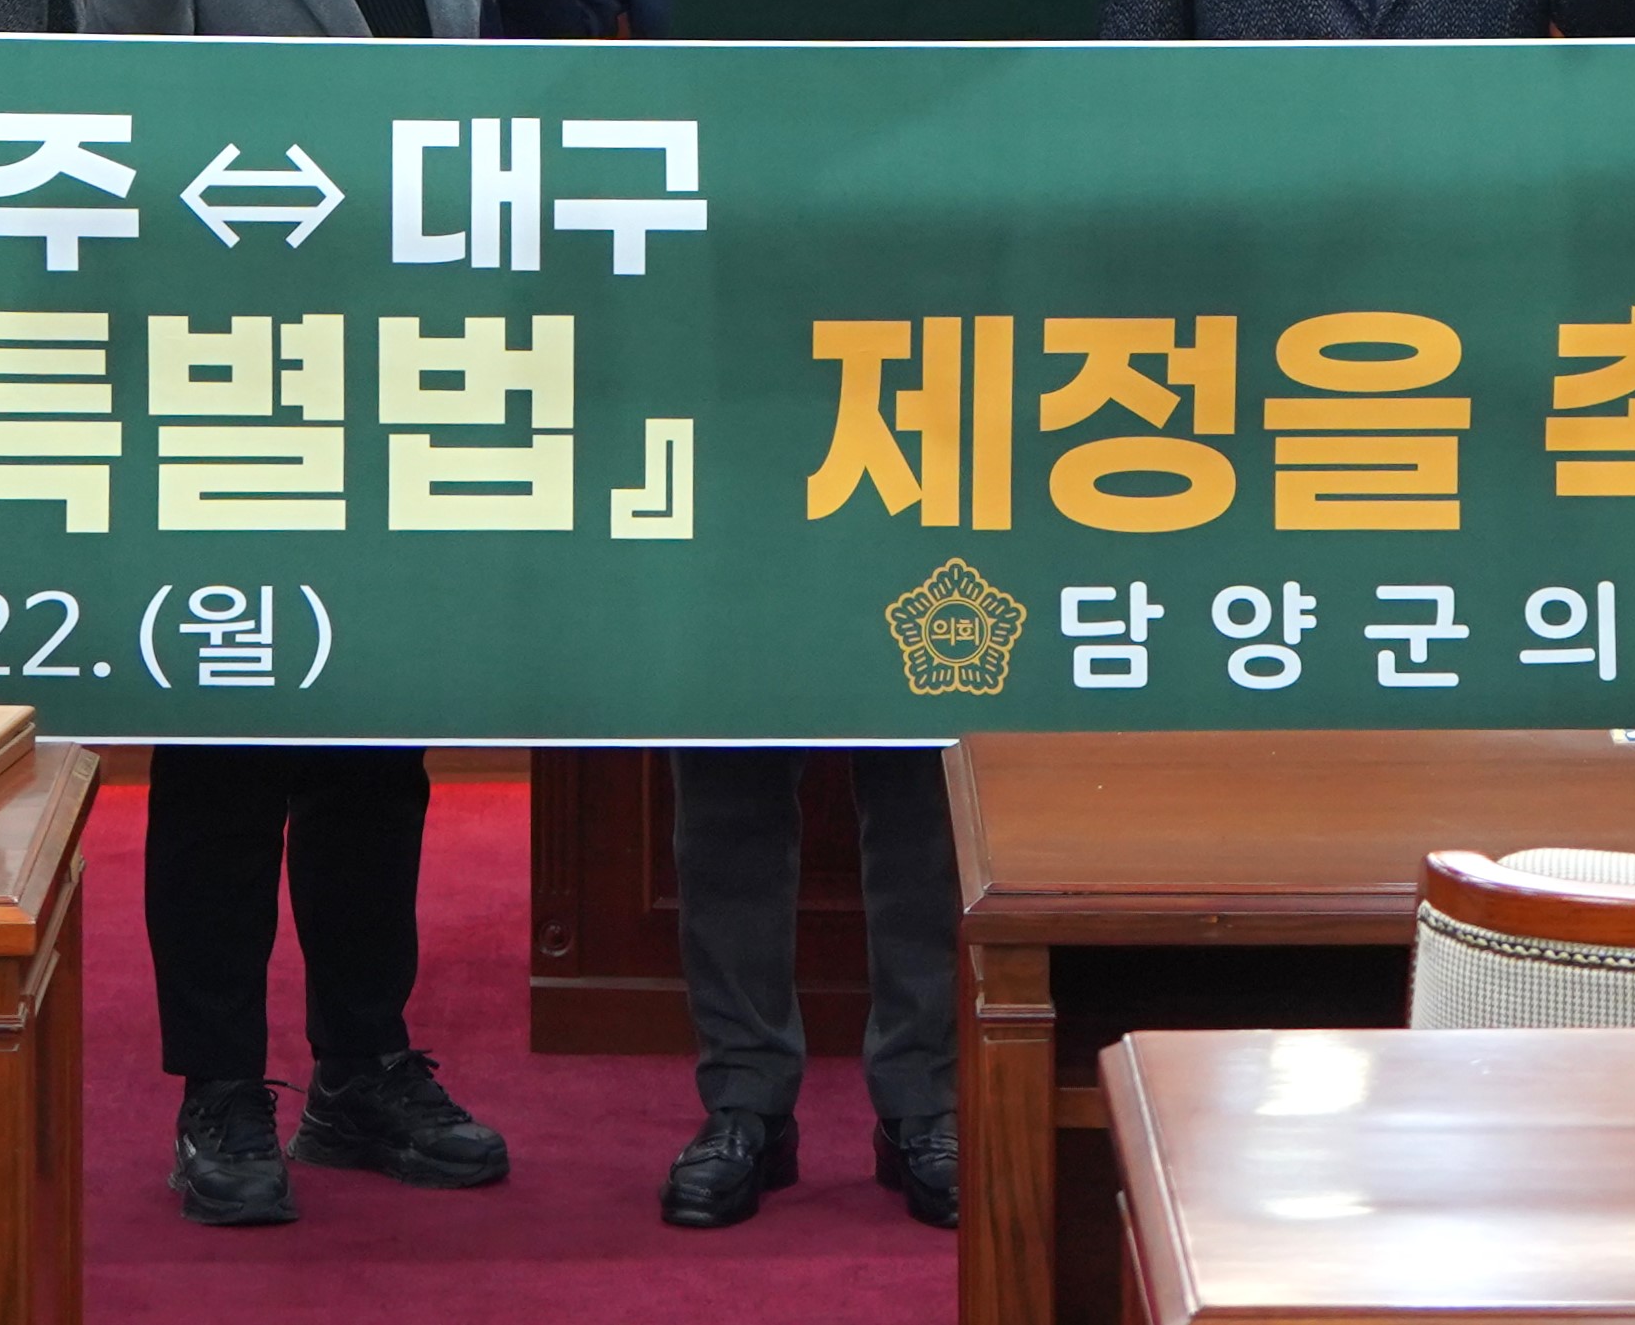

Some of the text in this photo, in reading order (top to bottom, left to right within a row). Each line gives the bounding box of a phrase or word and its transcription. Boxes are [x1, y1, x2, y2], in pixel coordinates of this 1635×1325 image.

[392, 118, 707, 274] 대구
[807, 312, 1471, 532] 제정을
[931, 617, 979, 646] 의회
